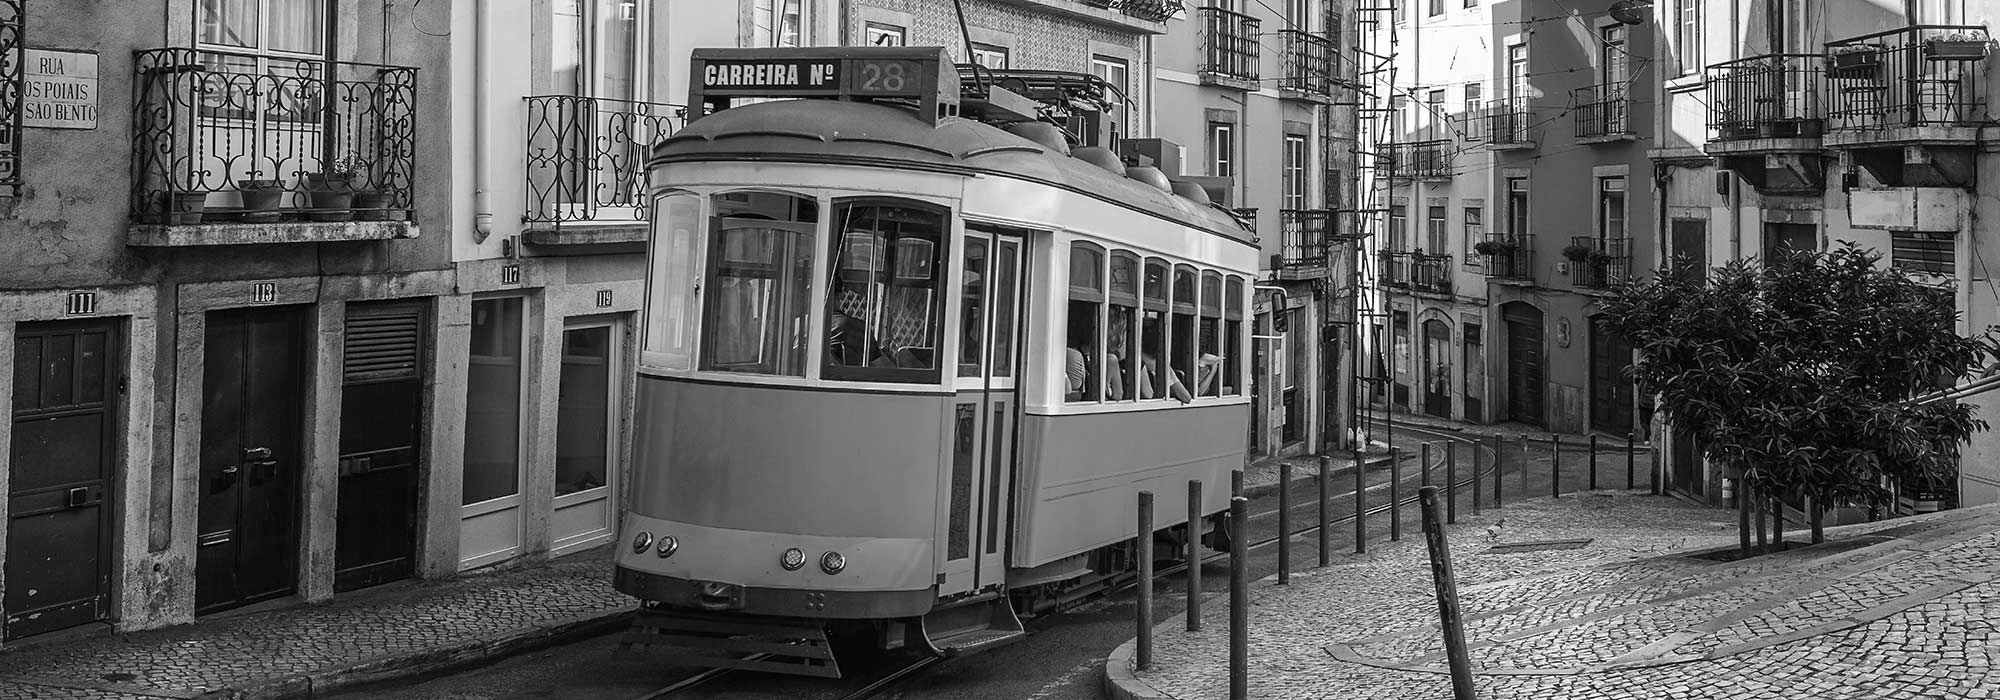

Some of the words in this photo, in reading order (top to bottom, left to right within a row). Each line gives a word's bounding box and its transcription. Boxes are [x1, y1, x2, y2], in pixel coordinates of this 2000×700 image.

[40, 57, 64, 75] RUA
[704, 64, 799, 86] CARREIRA
[862, 63, 904, 91] 28
[44, 81, 89, 100] POIAIS
[504, 267, 518, 282] 117
[254, 283, 273, 302] 113
[598, 291, 611, 306] 119
[70, 293, 93, 314] 111
